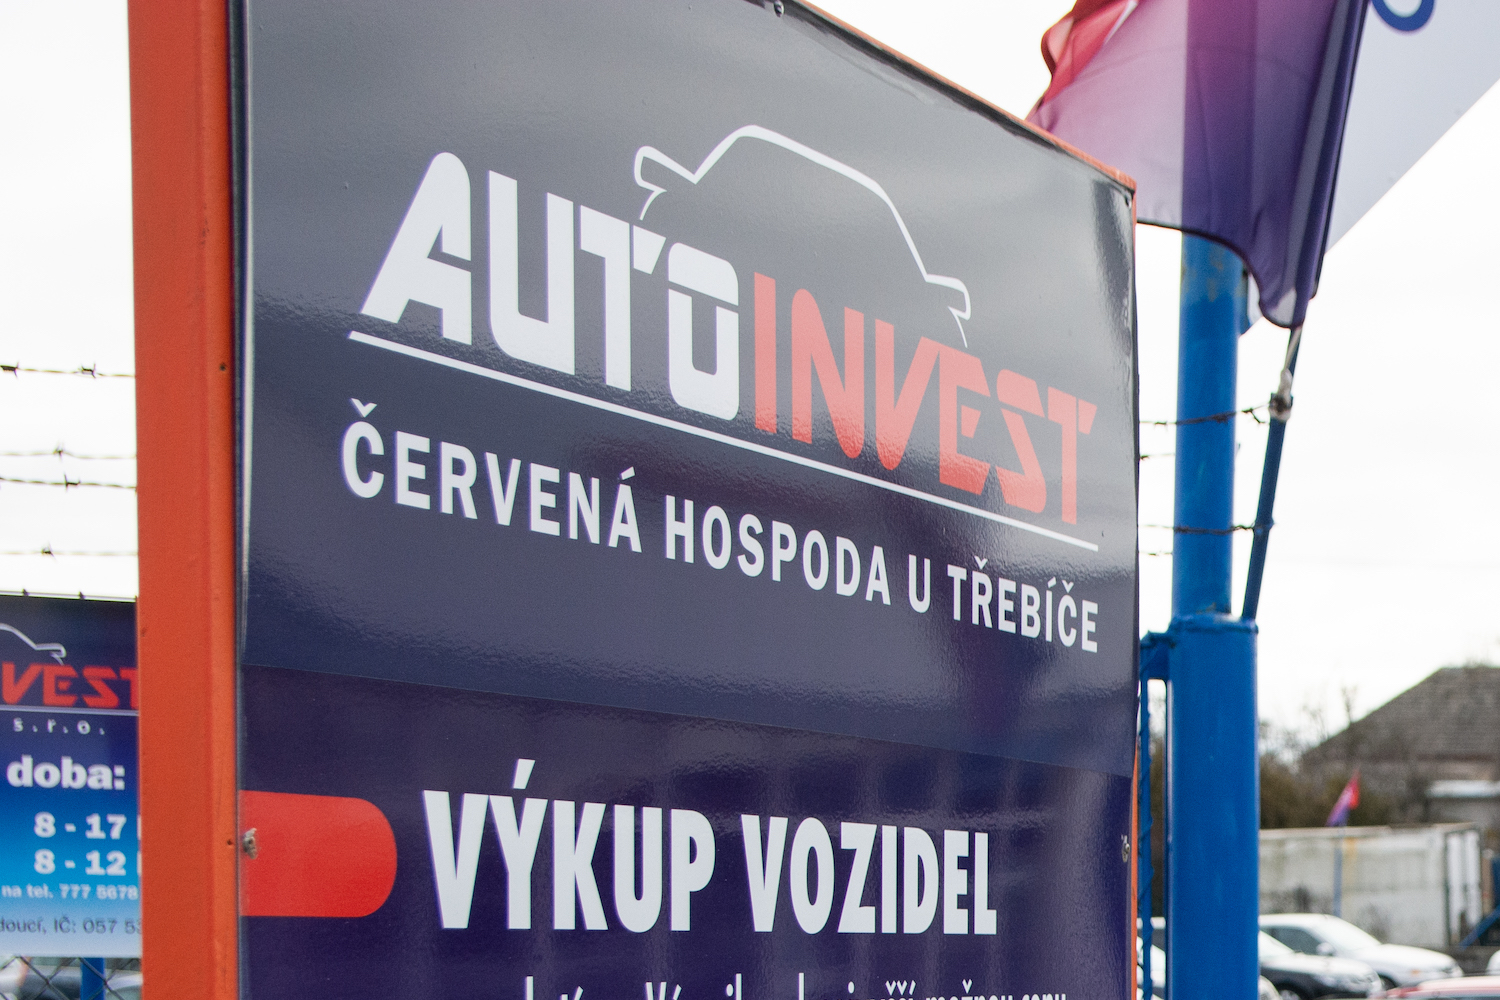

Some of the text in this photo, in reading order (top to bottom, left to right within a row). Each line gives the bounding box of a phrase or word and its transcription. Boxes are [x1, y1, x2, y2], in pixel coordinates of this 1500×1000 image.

[360, 152, 1099, 525] AUTOINVEST
[342, 398, 1099, 653] ČERVENÁ HOSPODA U TŘEBÍČE
[6, 755, 126, 790] doba:
[33, 811, 56, 838] 8
[85, 813, 127, 840] 17
[33, 849, 56, 875] 8
[85, 850, 127, 876] 12
[423, 759, 997, 934] VÝKUP VOZIDEL
[1, 885, 22, 898] na
[59, 883, 91, 899] 777
